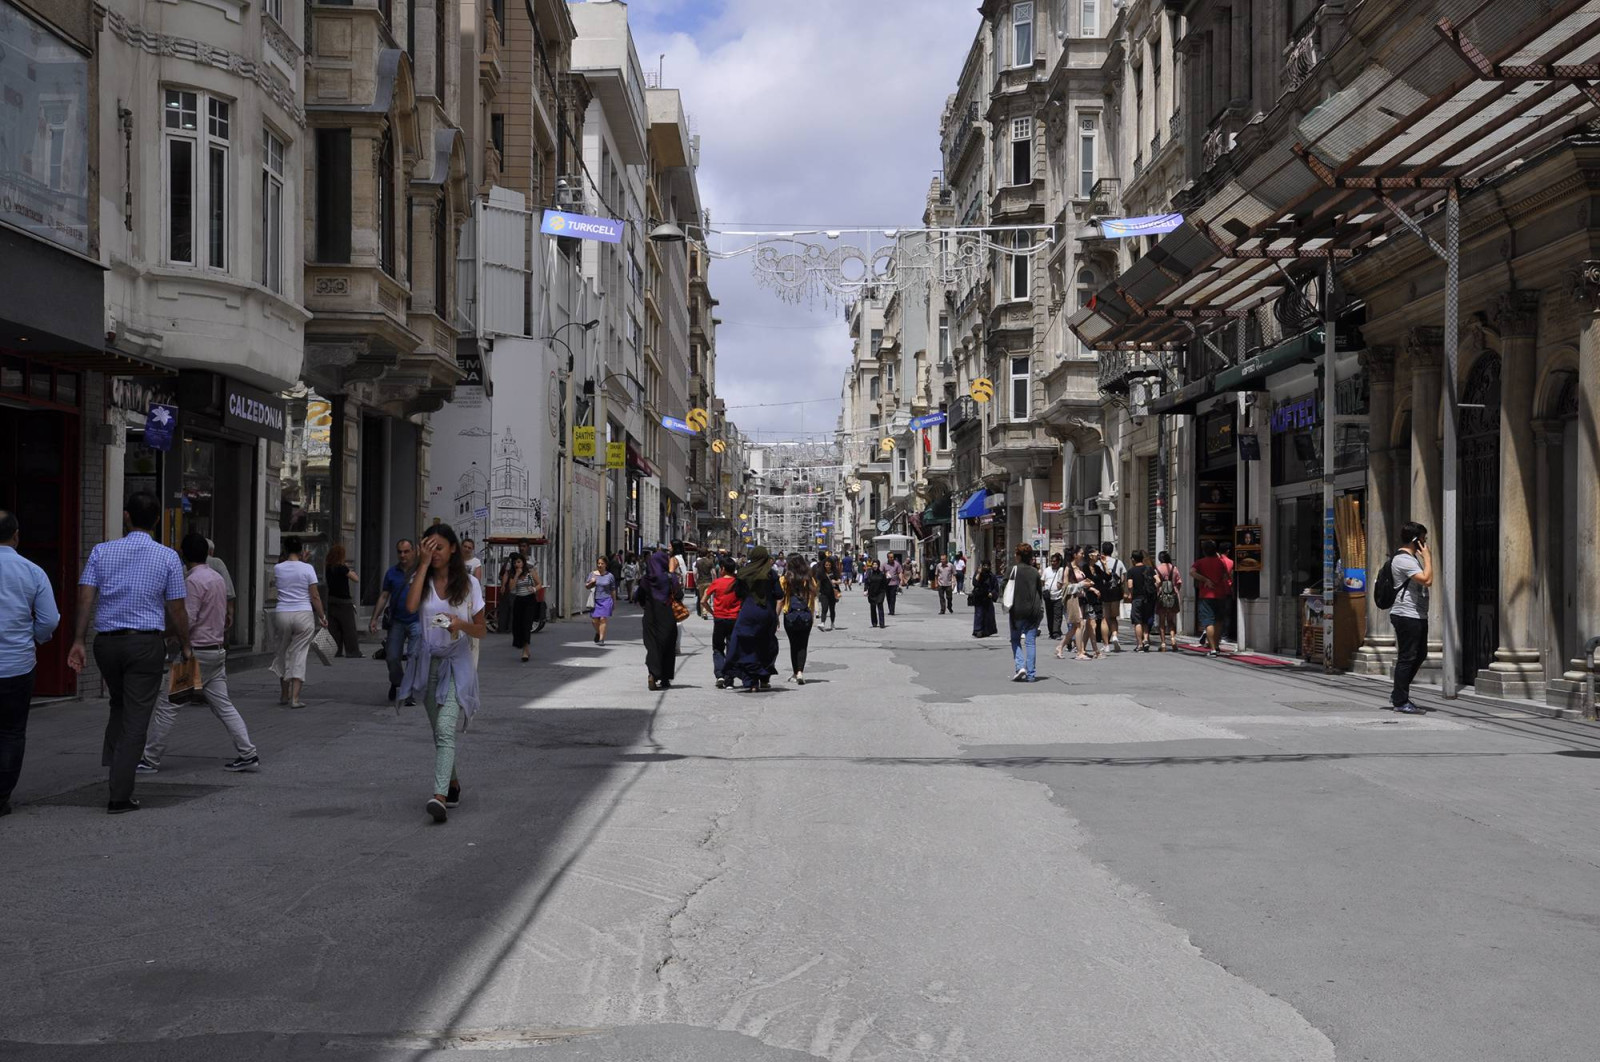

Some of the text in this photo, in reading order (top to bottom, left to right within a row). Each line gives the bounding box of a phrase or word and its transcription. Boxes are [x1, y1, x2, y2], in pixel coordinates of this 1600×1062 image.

[568, 221, 616, 236] TURKCELL
[1131, 218, 1179, 230] TURKCELL
[229, 393, 283, 431] CALZEDONIA
